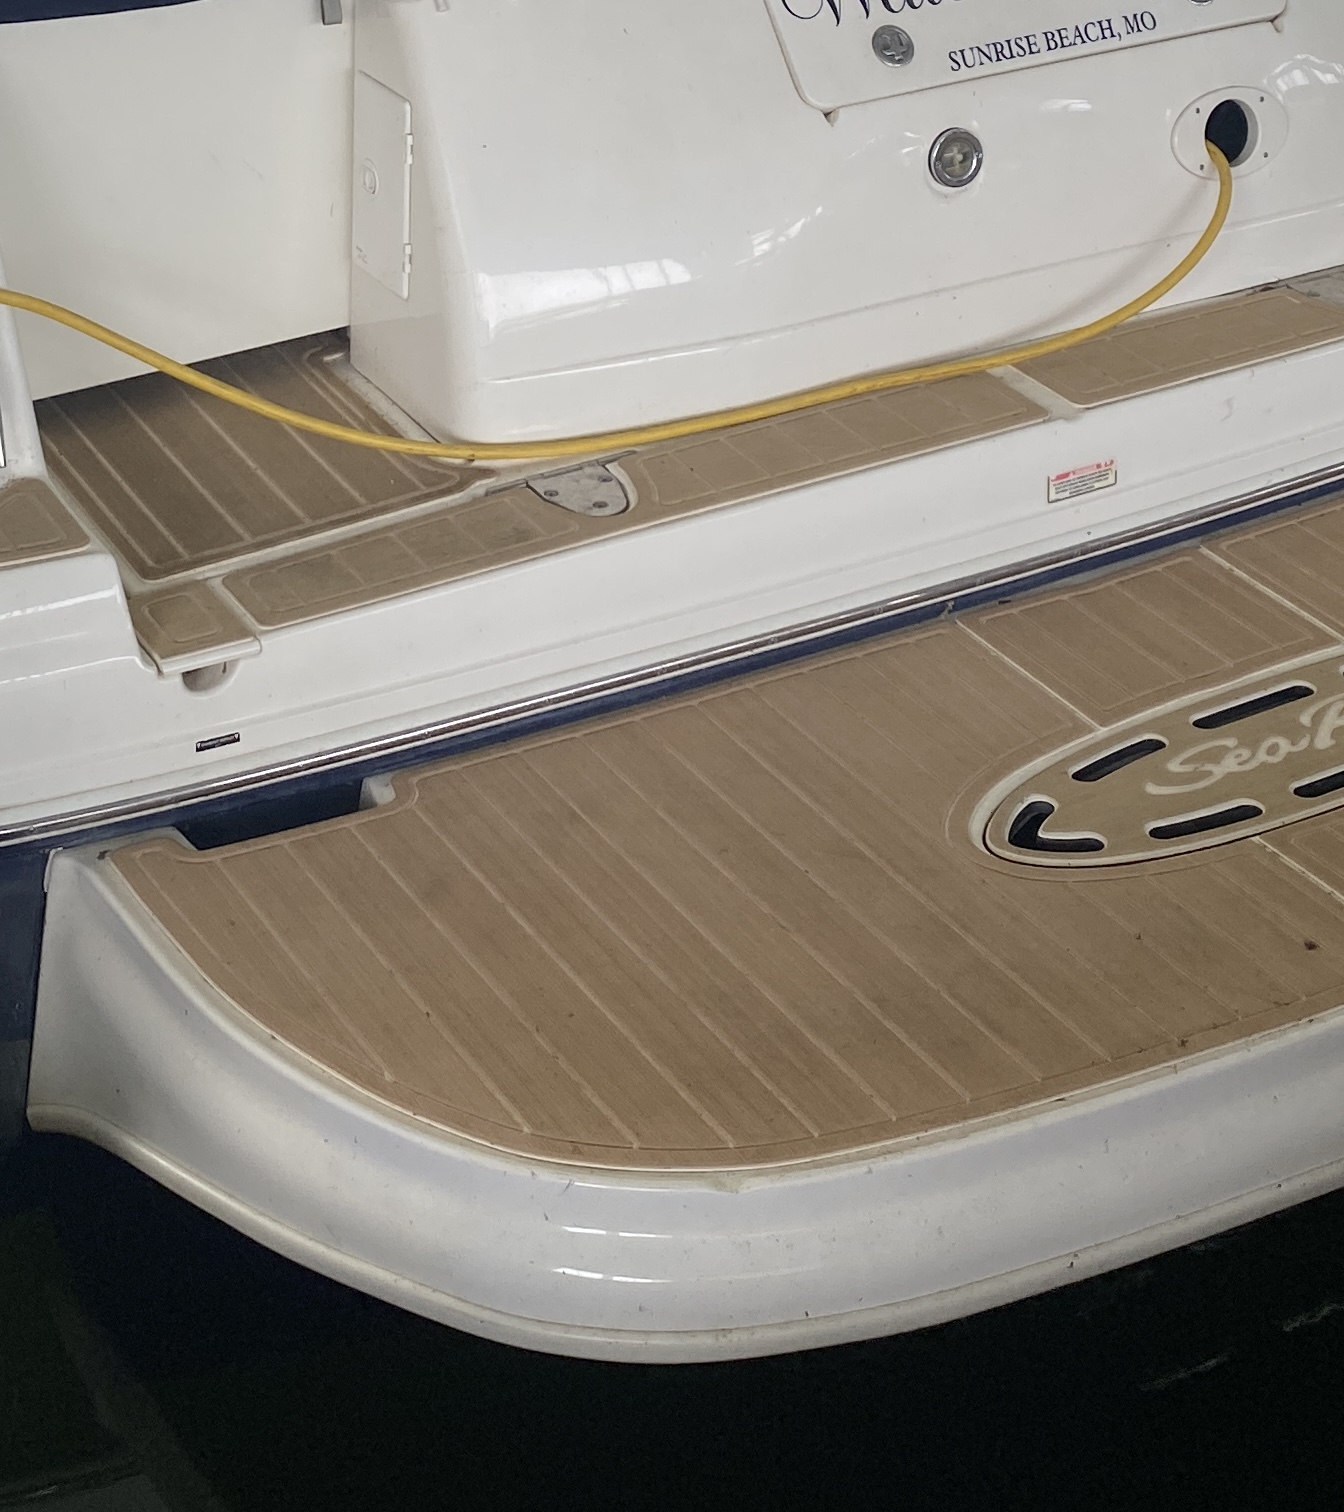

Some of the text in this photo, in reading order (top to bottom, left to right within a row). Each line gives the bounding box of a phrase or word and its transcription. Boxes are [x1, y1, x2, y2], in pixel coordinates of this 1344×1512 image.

[948, 10, 1157, 72] SUNRISE BEACH, MO
[1144, 734, 1311, 795] Sea
